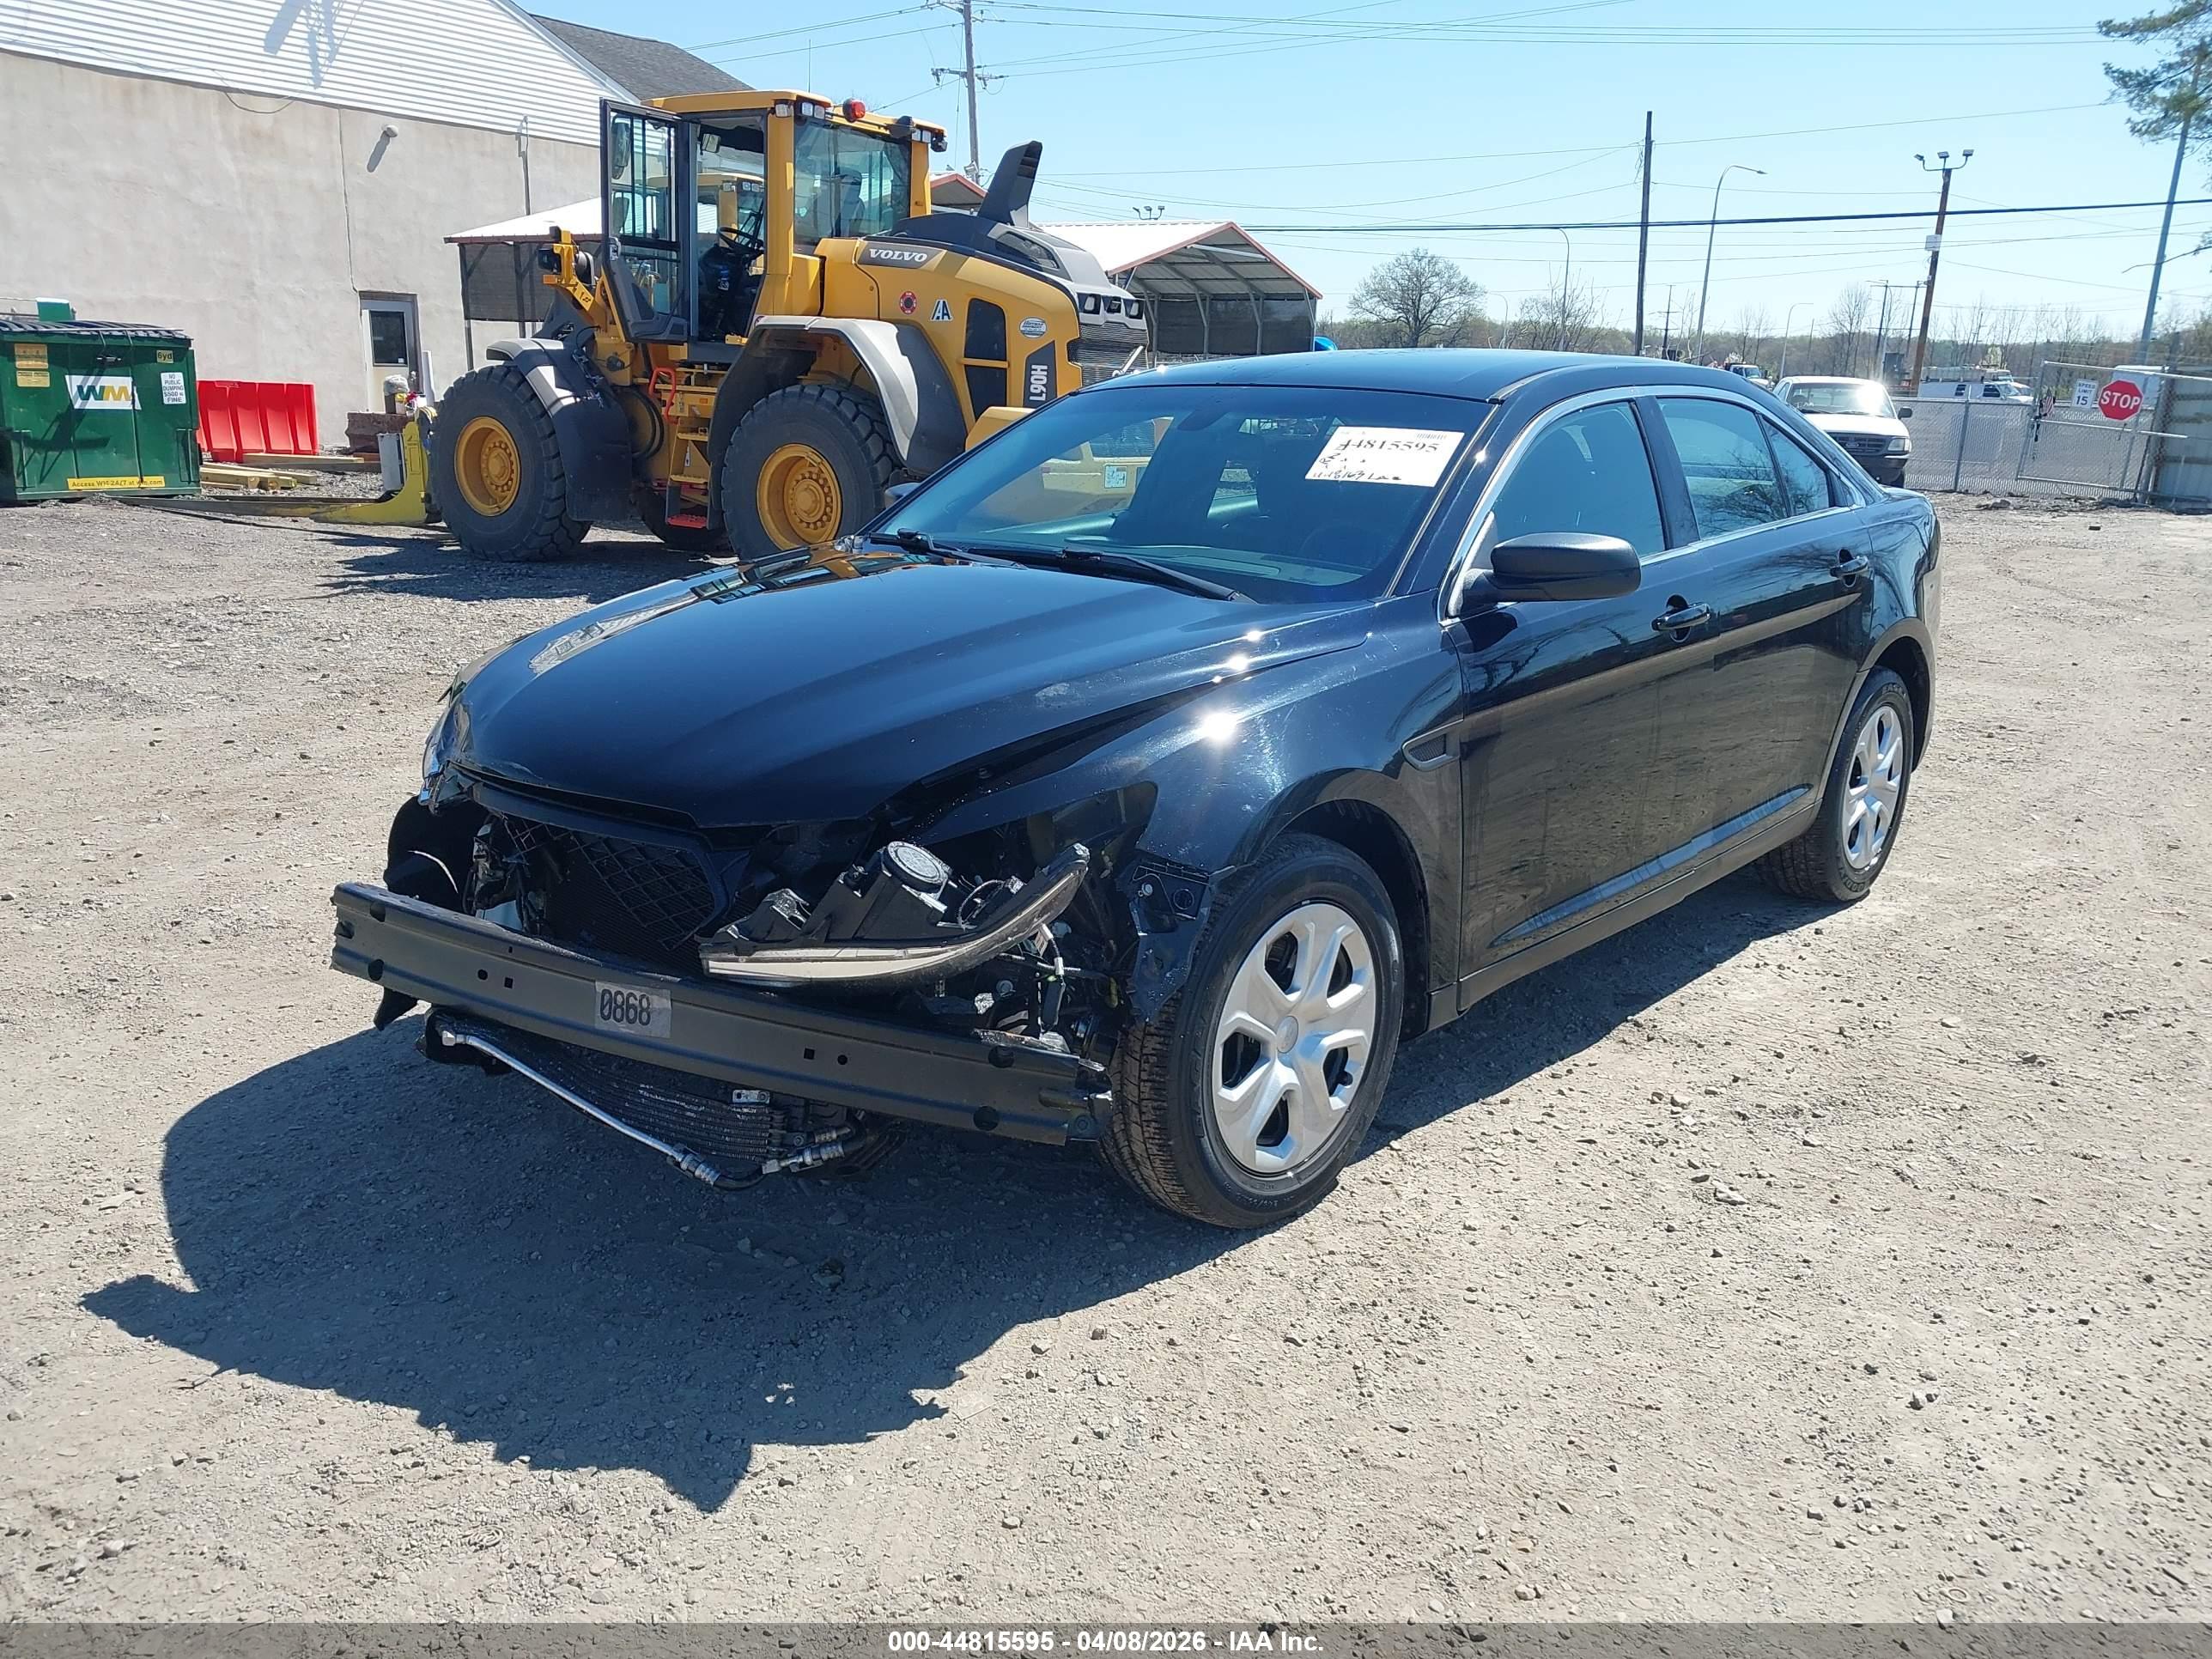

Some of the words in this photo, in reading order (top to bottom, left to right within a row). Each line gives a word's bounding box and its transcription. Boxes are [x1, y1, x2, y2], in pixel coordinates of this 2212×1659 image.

[869, 248, 927, 262] VOLVO
[1029, 364, 1048, 401] L90H
[76, 385, 131, 401] WM
[2076, 395, 2088, 405] 15
[2100, 390, 2141, 410] STOP
[1339, 439, 1440, 453] 44815595
[600, 988, 651, 1026] 0868
